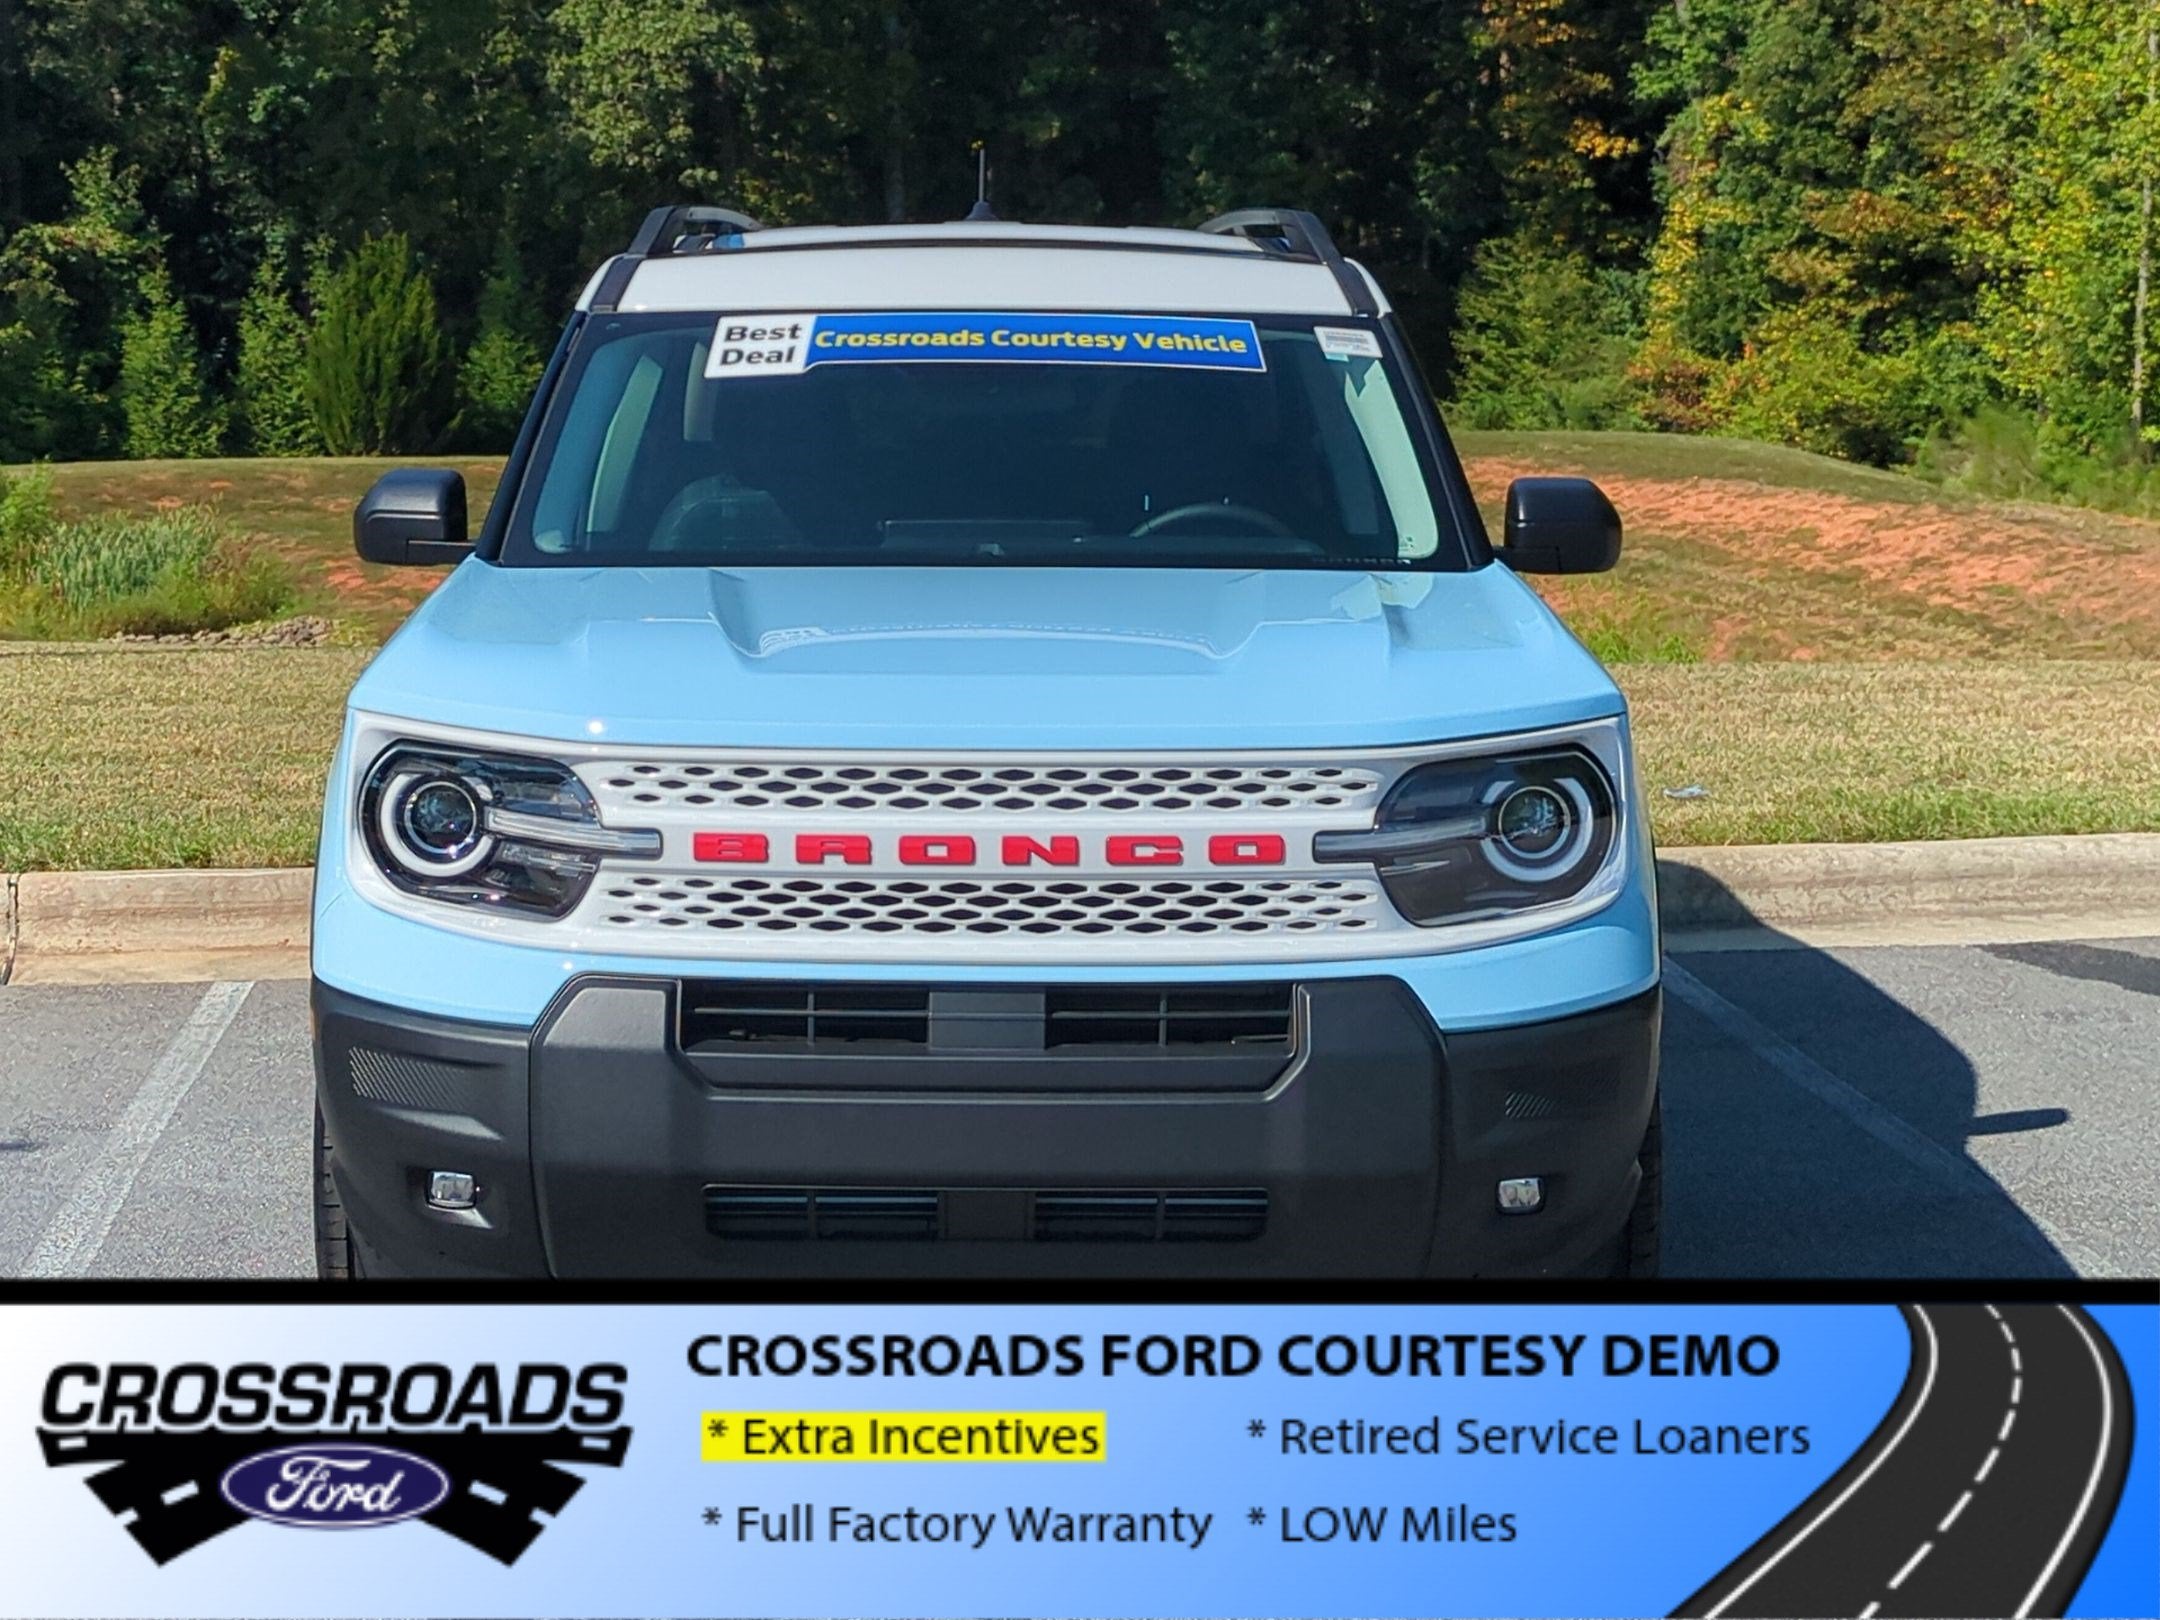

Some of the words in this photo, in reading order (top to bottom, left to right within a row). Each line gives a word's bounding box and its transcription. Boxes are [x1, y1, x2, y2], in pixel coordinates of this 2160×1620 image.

[724, 323, 802, 342] Best
[815, 330, 985, 347] Crossroads
[991, 330, 1127, 351] Courtesy
[1132, 332, 1248, 353] Vehicle
[719, 346, 795, 366] Deal
[693, 832, 1286, 866] BRONCO
